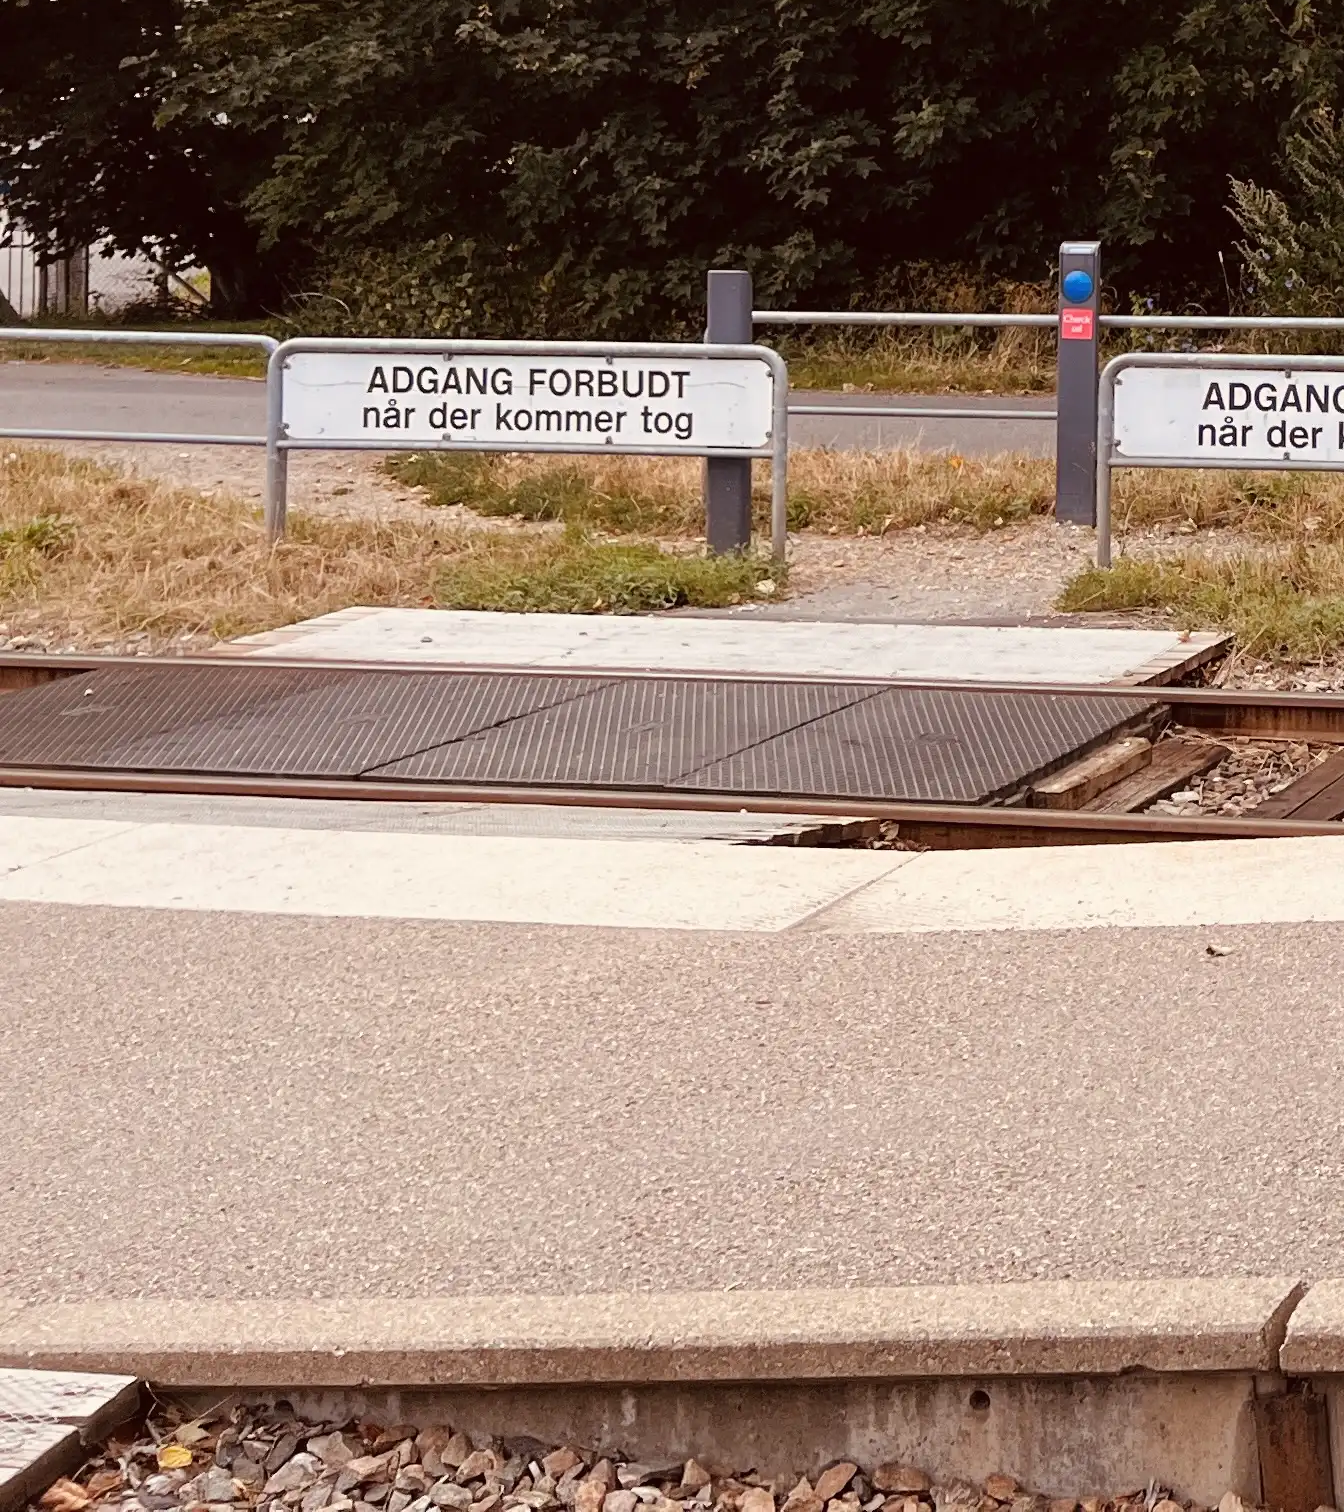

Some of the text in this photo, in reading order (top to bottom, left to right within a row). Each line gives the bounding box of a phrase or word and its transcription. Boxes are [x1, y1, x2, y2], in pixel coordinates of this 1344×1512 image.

[366, 365, 691, 399] ADGANG FORBUDT
[362, 399, 694, 440] når der kommer tog
[1197, 416, 1254, 446] når
[1266, 420, 1323, 449] der
